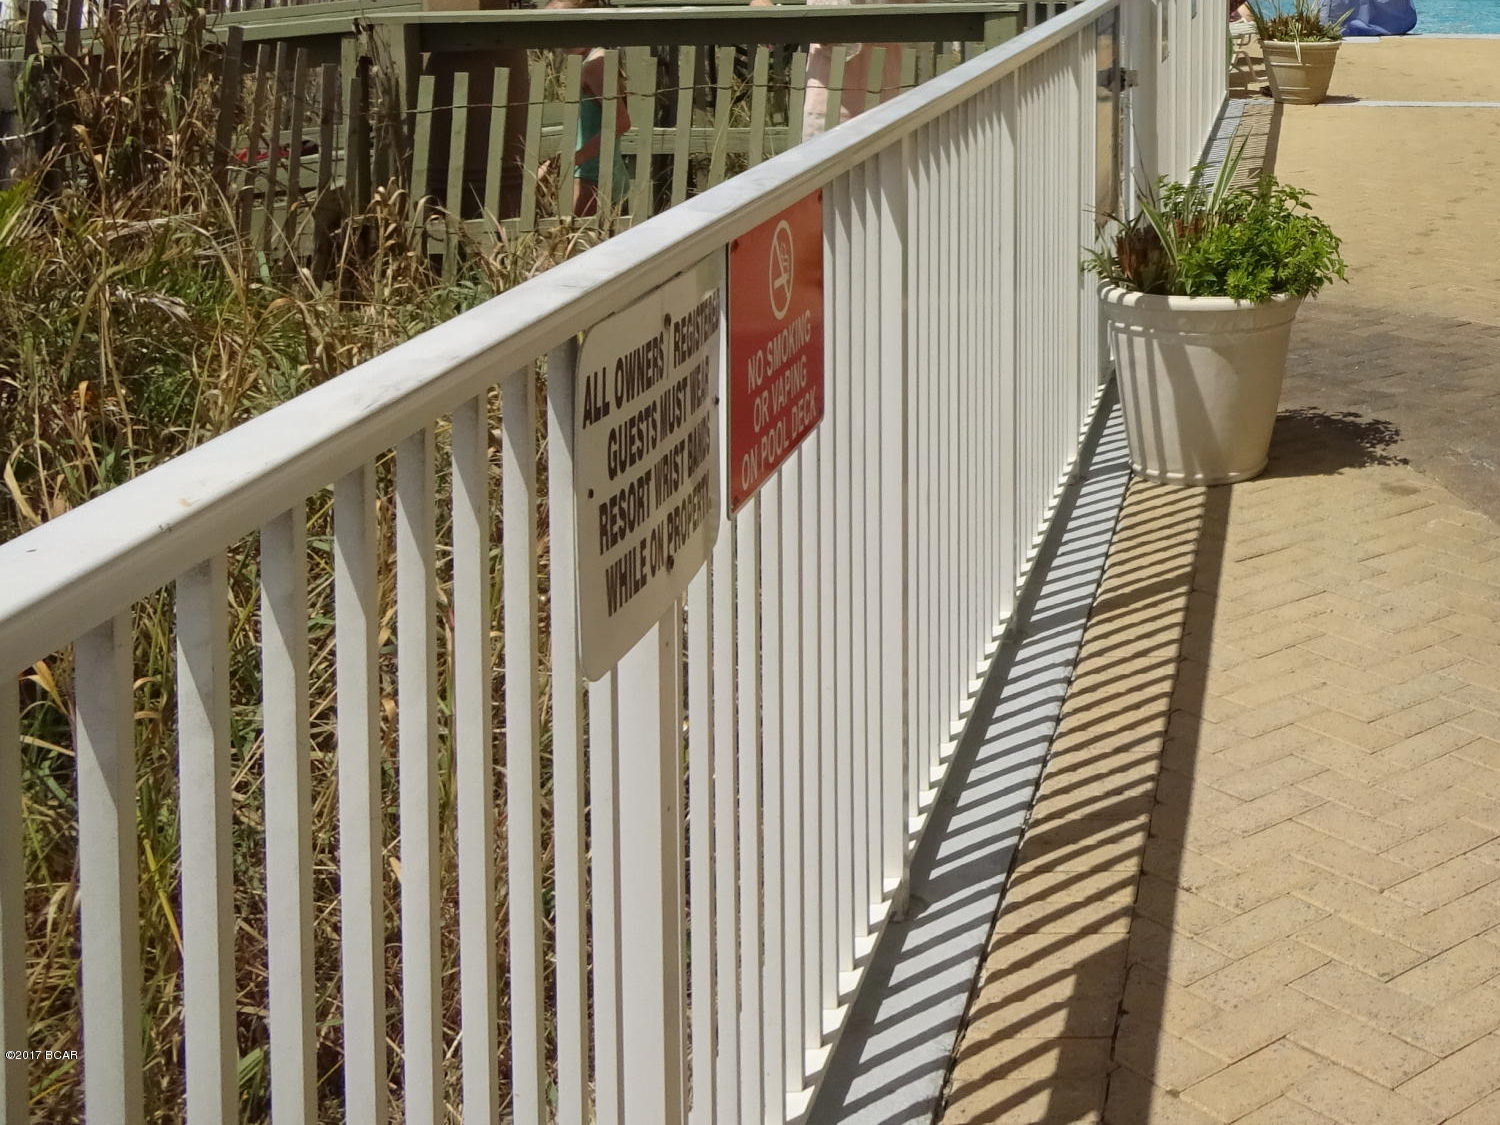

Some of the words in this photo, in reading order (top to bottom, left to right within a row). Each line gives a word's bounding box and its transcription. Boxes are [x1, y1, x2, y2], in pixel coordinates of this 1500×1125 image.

[582, 367, 610, 429] ALL
[614, 331, 664, 410] OWNERS
[747, 349, 764, 395] NO
[767, 309, 811, 377] SMOKING
[753, 390, 769, 433] OR
[771, 354, 807, 415] VAPING
[607, 400, 657, 481] GUESTS
[660, 376, 688, 442] MUST
[689, 355, 709, 416] WEAR
[741, 444, 758, 491] ON
[761, 416, 789, 472] POOL
[791, 386, 817, 438] DECK
[599, 468, 652, 556] RESORT
[654, 438, 685, 510] WRIST
[687, 410, 711, 479] BANDS
[605, 537, 647, 618] WHILE
[650, 519, 664, 578] ON
